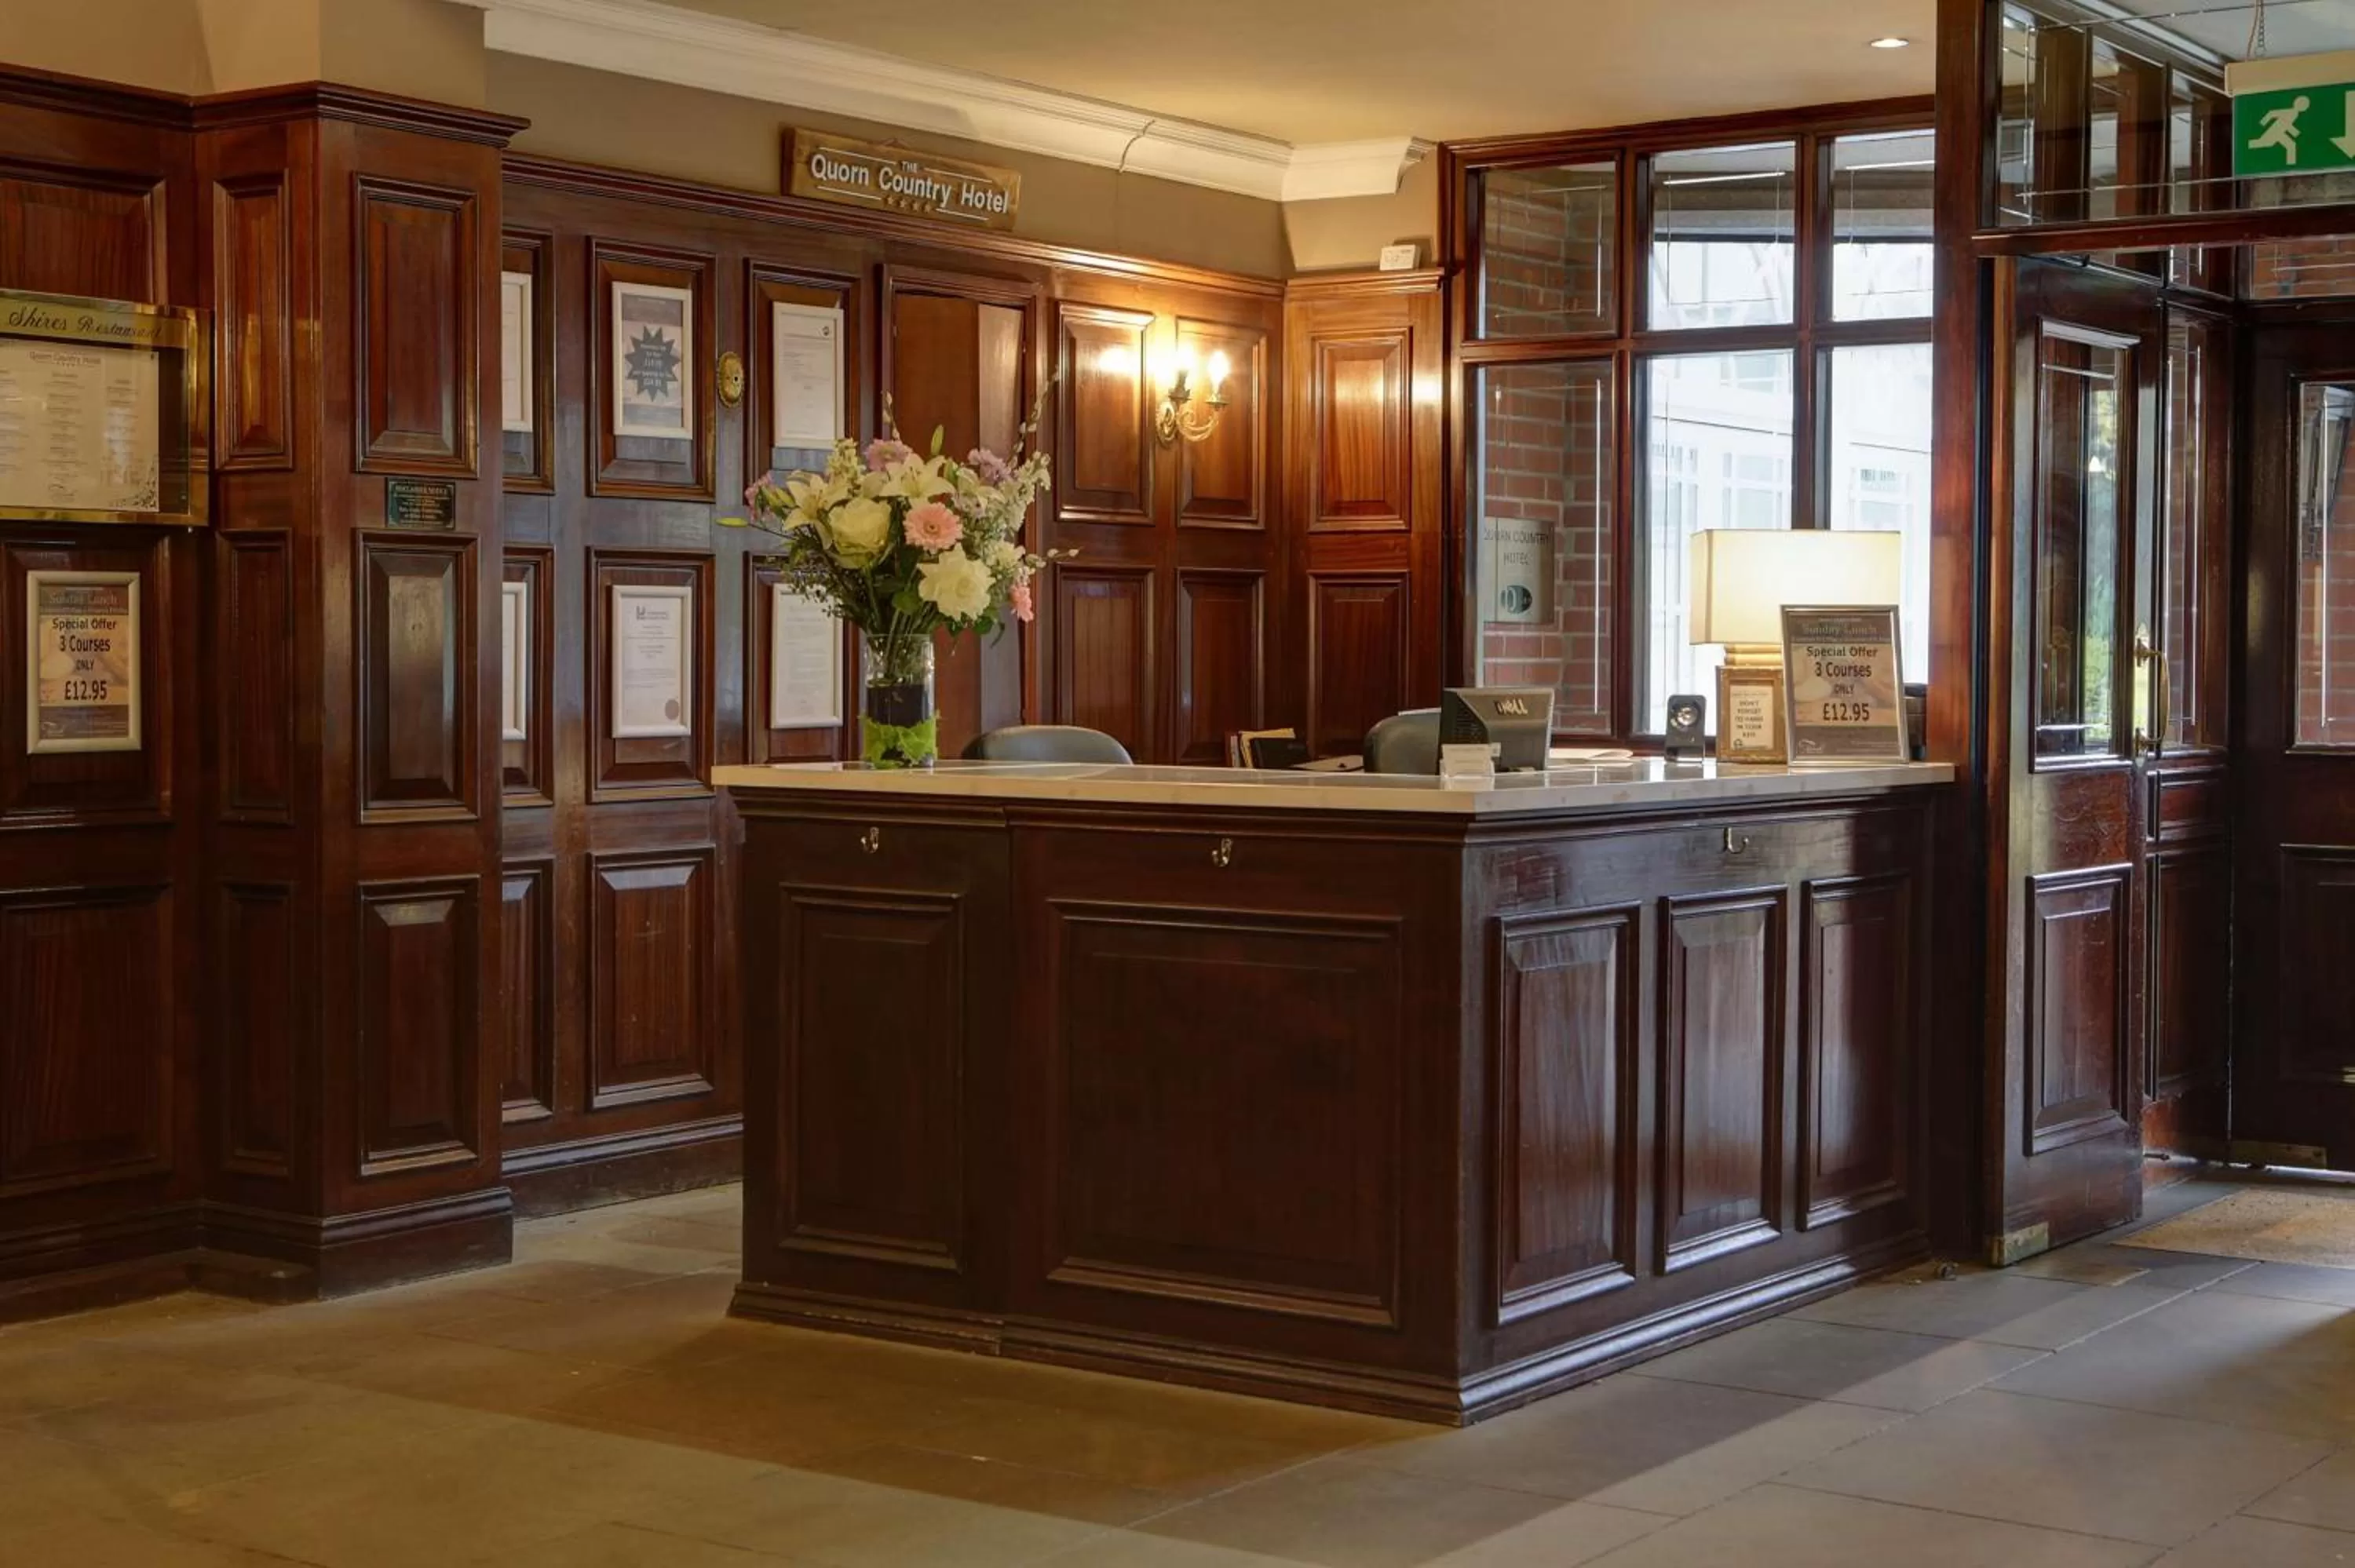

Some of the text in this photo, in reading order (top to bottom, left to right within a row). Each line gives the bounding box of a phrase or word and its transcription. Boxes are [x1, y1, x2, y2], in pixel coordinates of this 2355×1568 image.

[810, 154, 1009, 213] Quorn Country Hotel
[9, 306, 68, 330] Shires
[51, 617, 117, 632] Special Offer
[59, 635, 111, 653] 3 Courses
[1806, 646, 1879, 658] Special Offer
[75, 659, 95, 671] ONLY
[1814, 662, 1872, 677] 3 Courses
[64, 680, 108, 701] £12.95
[1833, 683, 1855, 695] ONLY
[1822, 702, 1871, 722] £12.95
